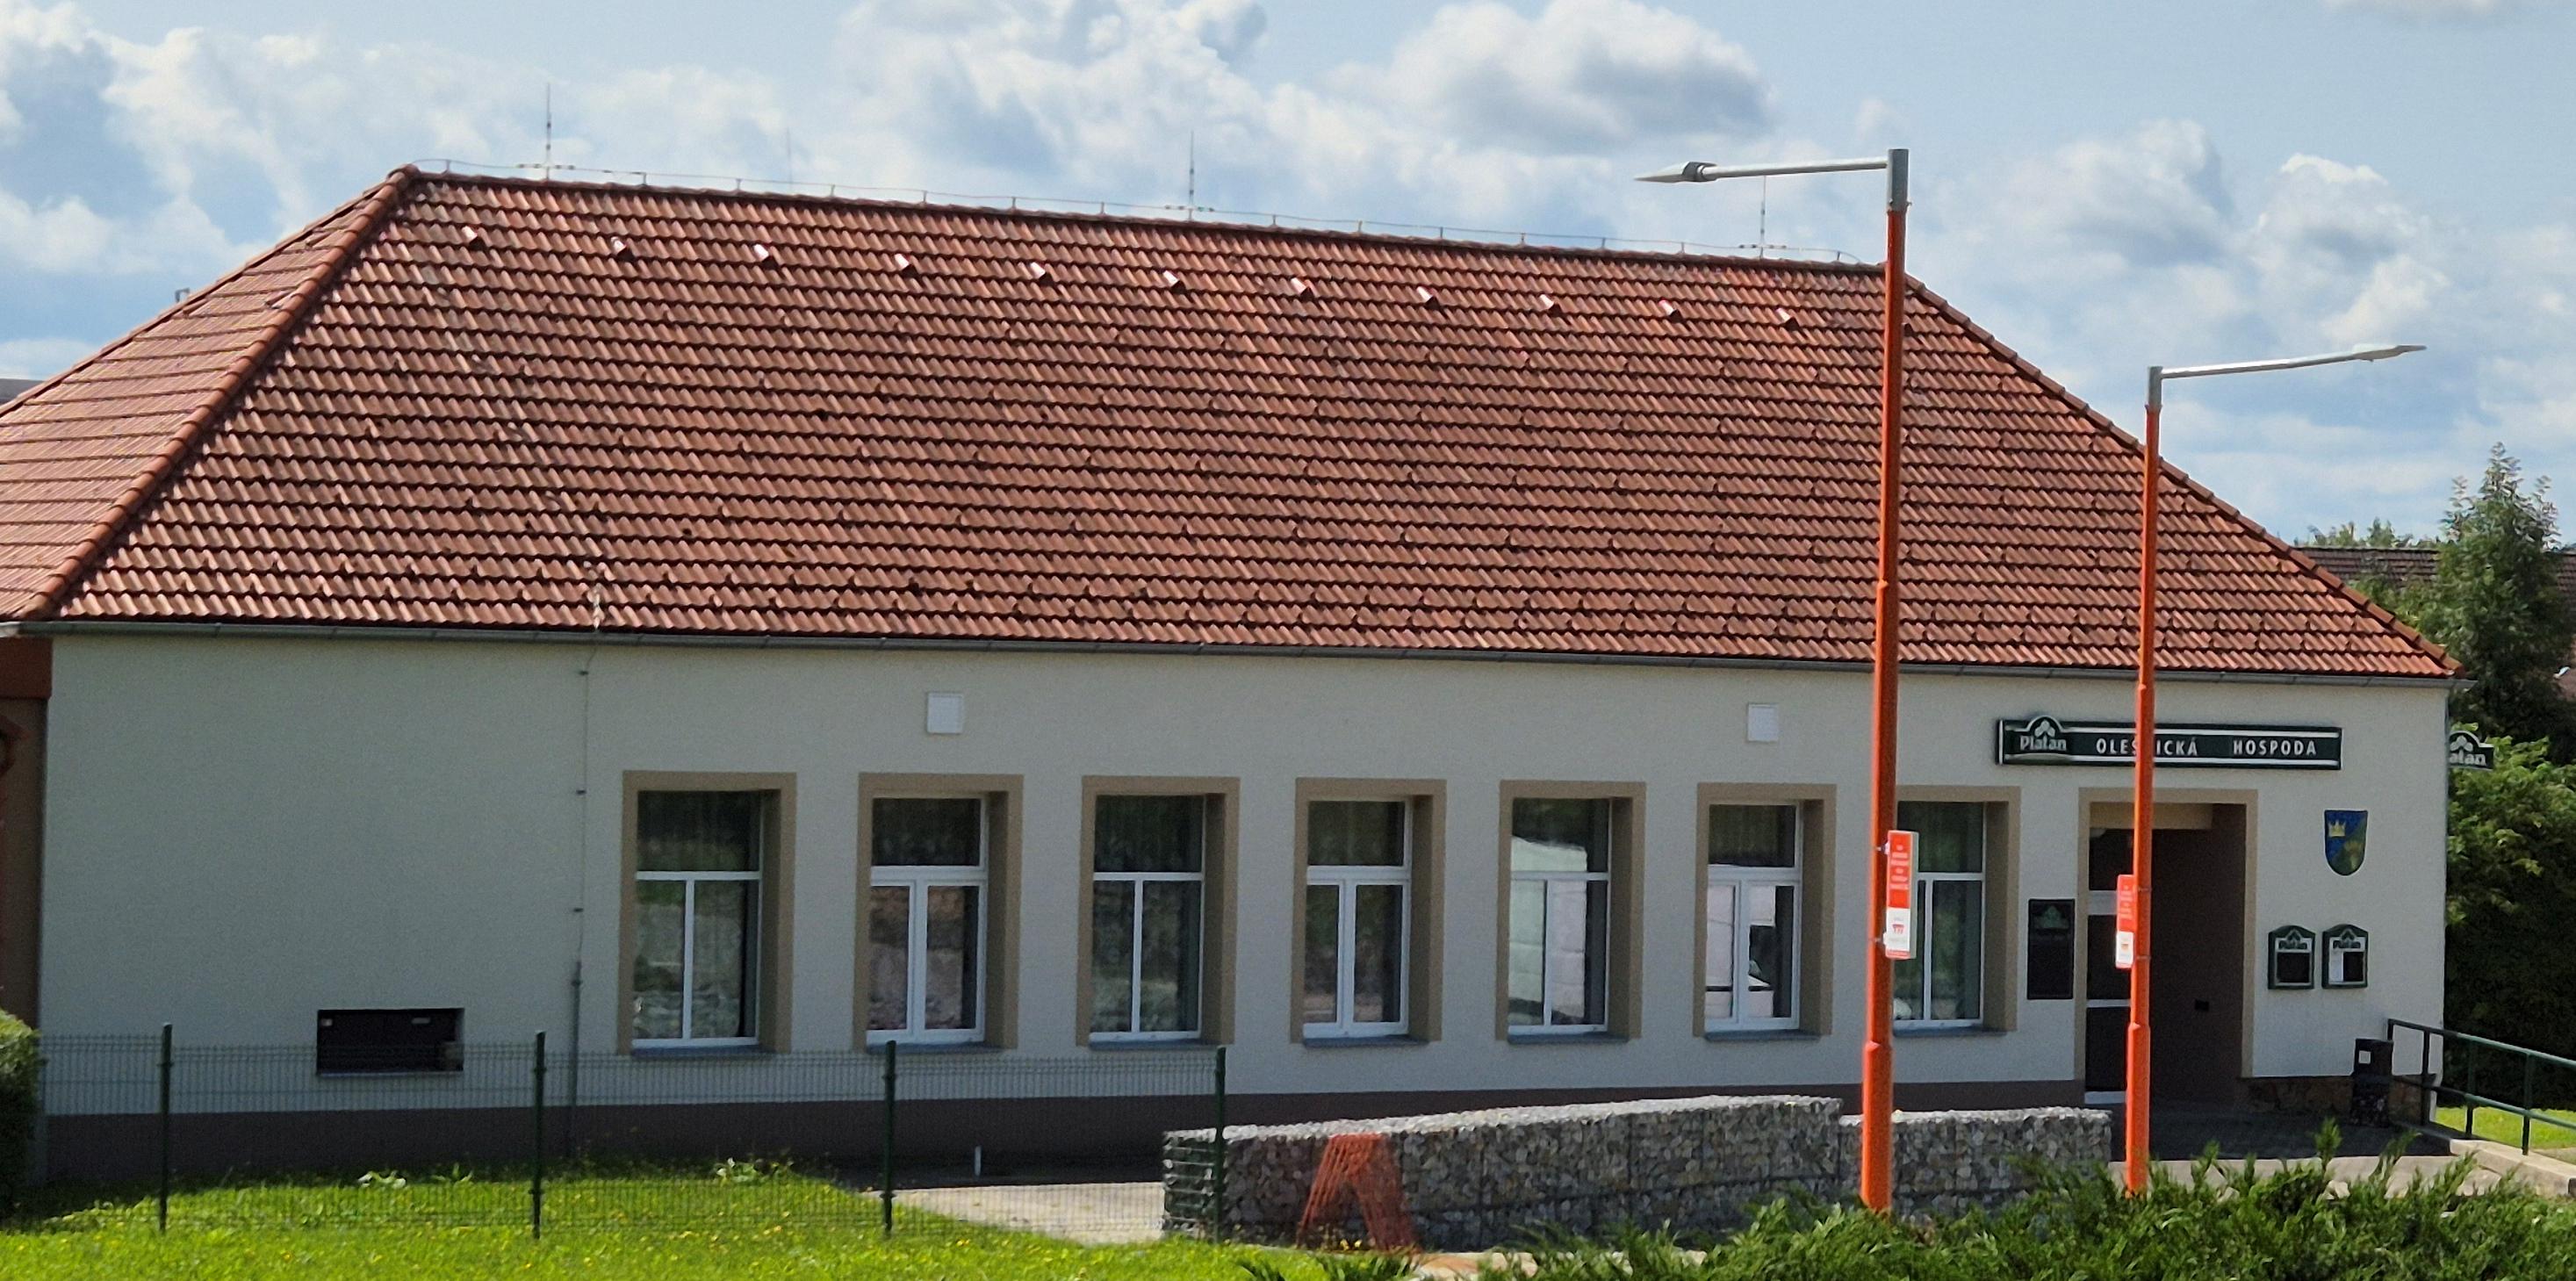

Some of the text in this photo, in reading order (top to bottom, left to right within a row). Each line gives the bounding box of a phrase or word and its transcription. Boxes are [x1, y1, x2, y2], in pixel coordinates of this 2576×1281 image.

[2020, 735, 2067, 751] Platan
[2096, 738, 2317, 756] OLEICKÁ HOSPODA
[2450, 749, 2486, 766] atan
